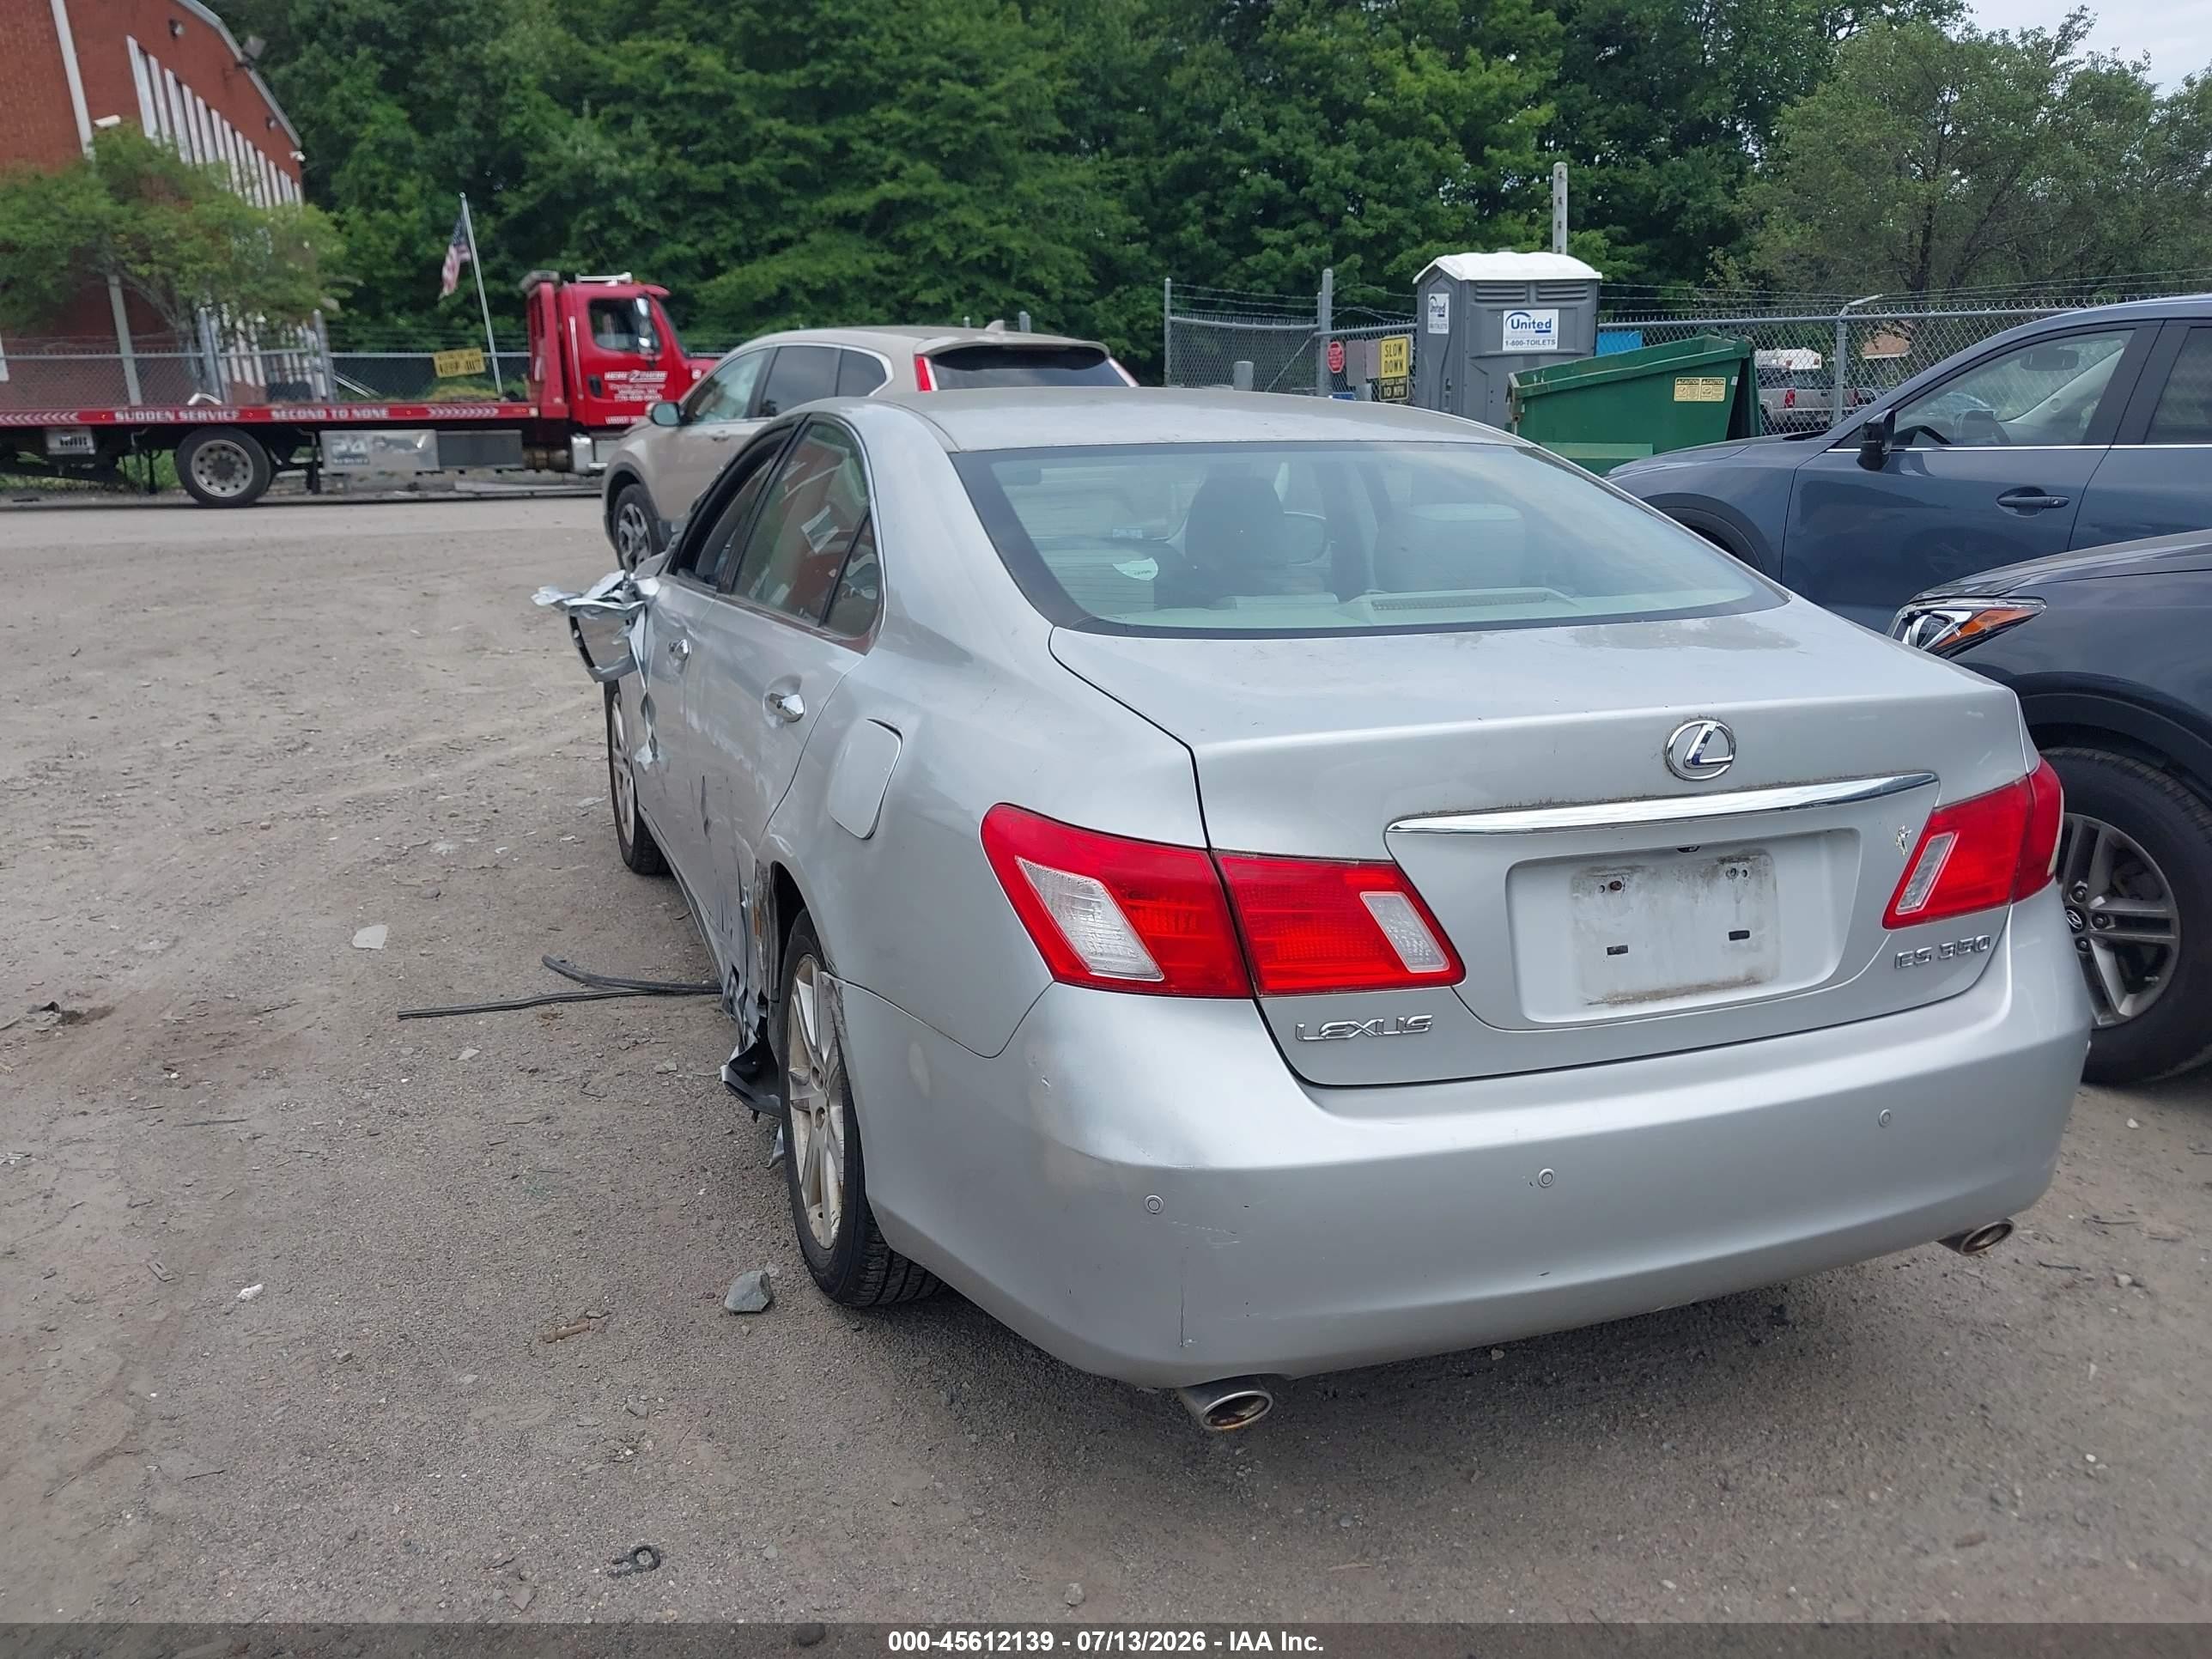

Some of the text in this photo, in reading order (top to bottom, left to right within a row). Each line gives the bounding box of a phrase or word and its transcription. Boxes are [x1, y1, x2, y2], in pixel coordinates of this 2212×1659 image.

[1510, 318, 1553, 330] United
[1505, 338, 1556, 347] 1-800-TOILETS
[1384, 343, 1403, 358] SLOW
[1384, 359, 1404, 373] DOWN
[1383, 386, 1392, 398] 10
[115, 410, 240, 422] SUDDEN SERVICE
[270, 407, 388, 420] SECOND TO NONE
[1894, 934, 1991, 969] ES 350
[1295, 1014, 1433, 1042] LEXUS
